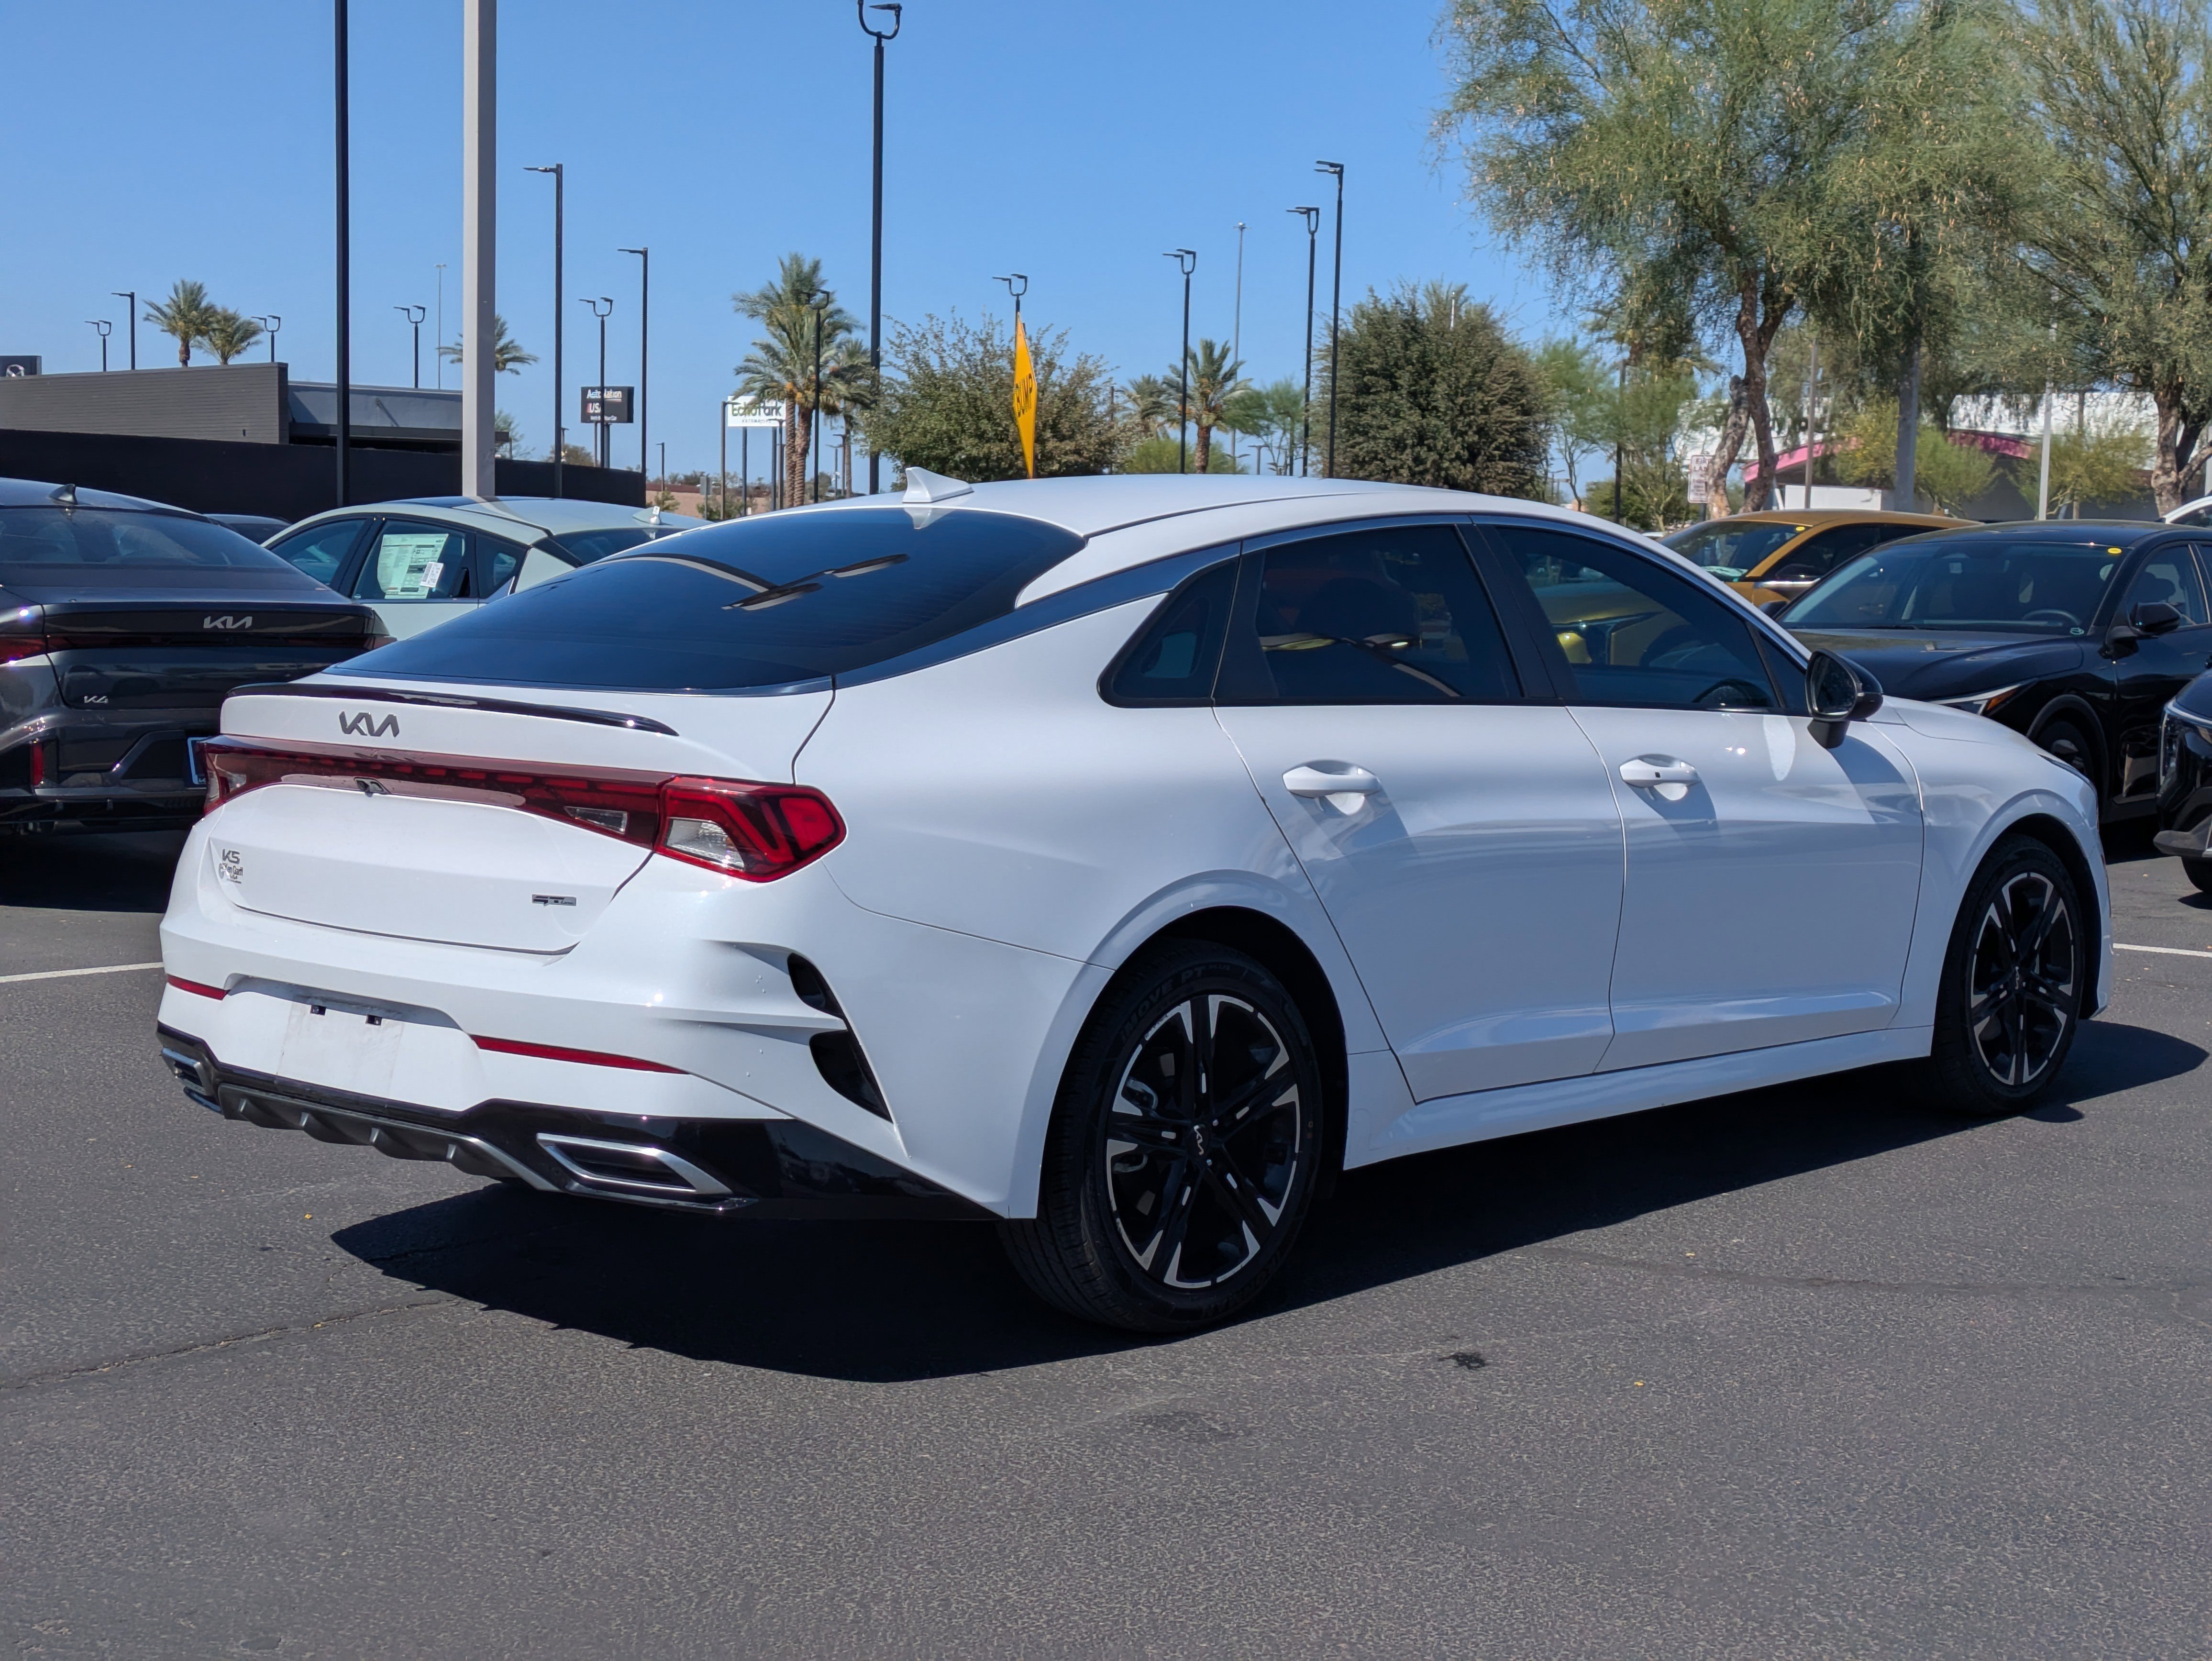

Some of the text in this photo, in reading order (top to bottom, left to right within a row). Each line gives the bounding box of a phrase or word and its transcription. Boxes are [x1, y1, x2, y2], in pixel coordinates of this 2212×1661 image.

[1015, 373, 1033, 418] BUMP
[203, 616, 253, 629] KIA
[84, 696, 109, 704] K4
[339, 711, 399, 737] KIA
[222, 849, 240, 864] K5
